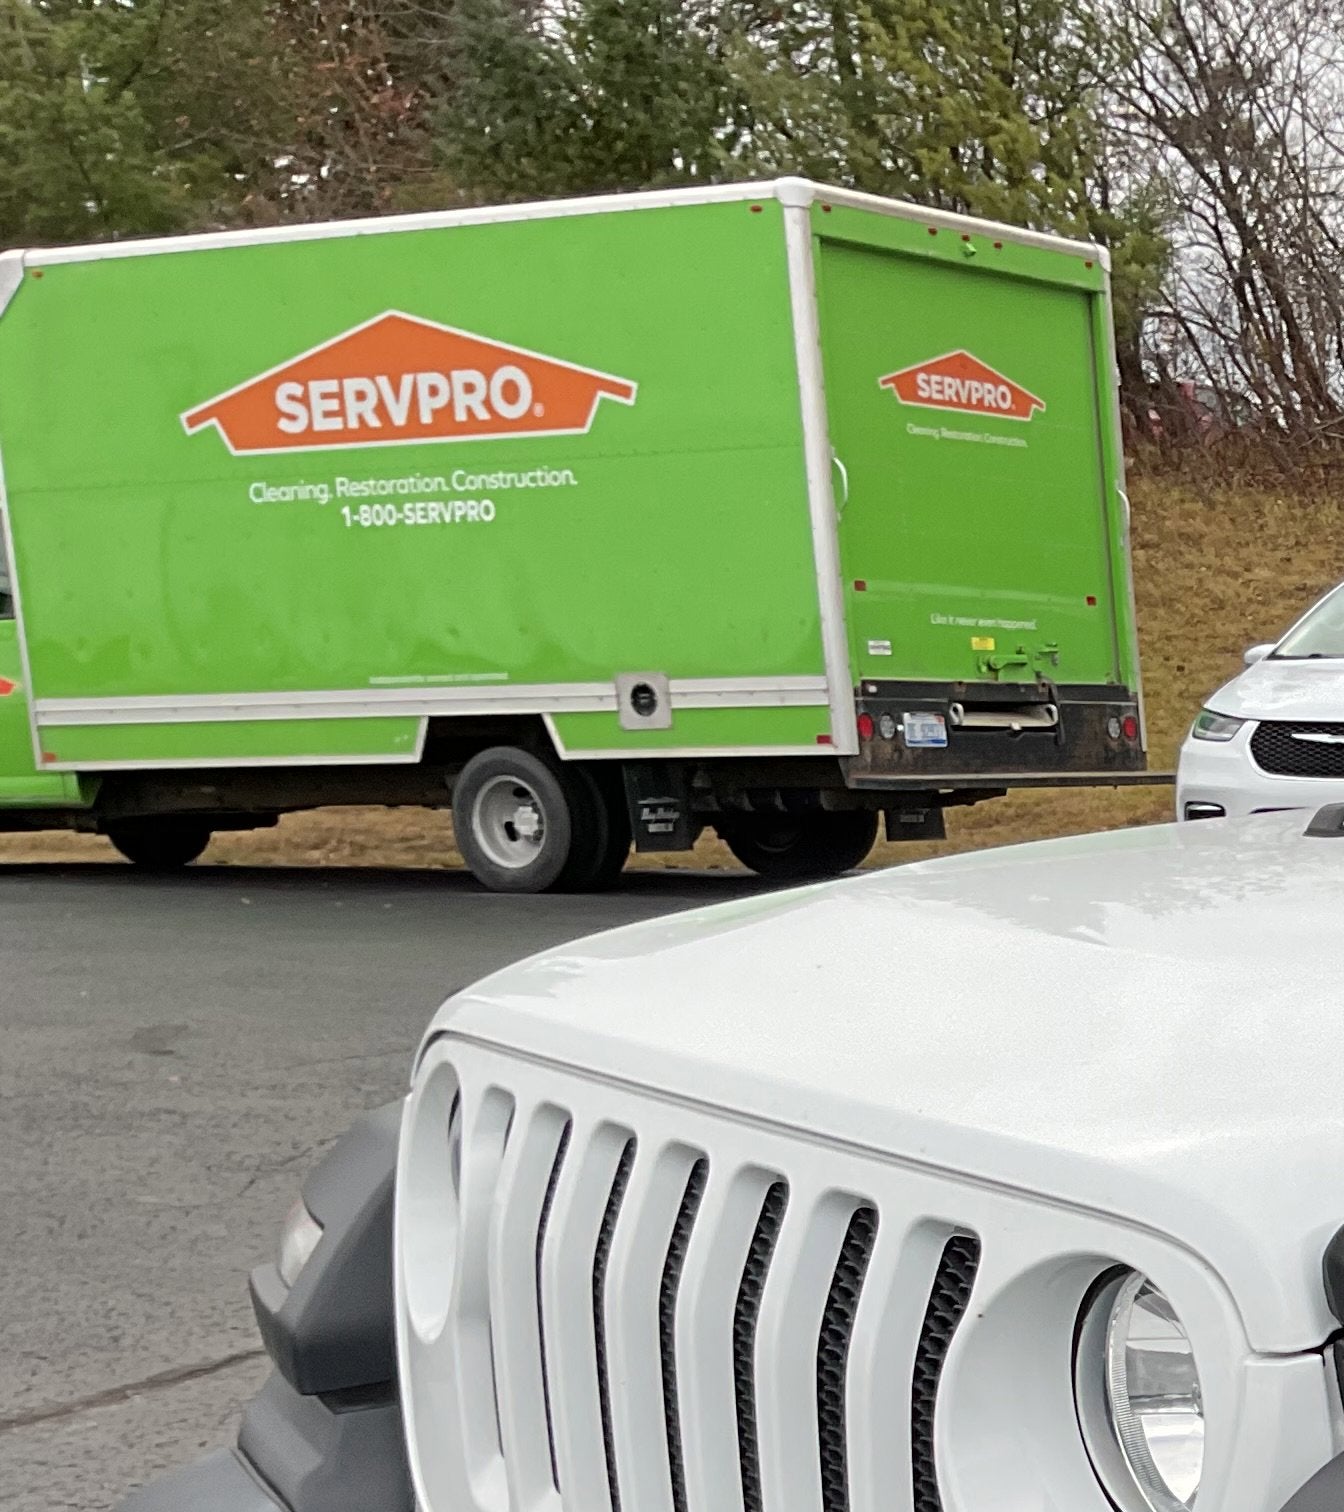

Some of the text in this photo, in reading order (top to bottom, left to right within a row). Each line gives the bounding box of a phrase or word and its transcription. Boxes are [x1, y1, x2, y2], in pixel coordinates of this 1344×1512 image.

[249, 466, 578, 505] Cleaning. Restoration. Construction.
[340, 498, 496, 528] 1-800-SERVPRO
